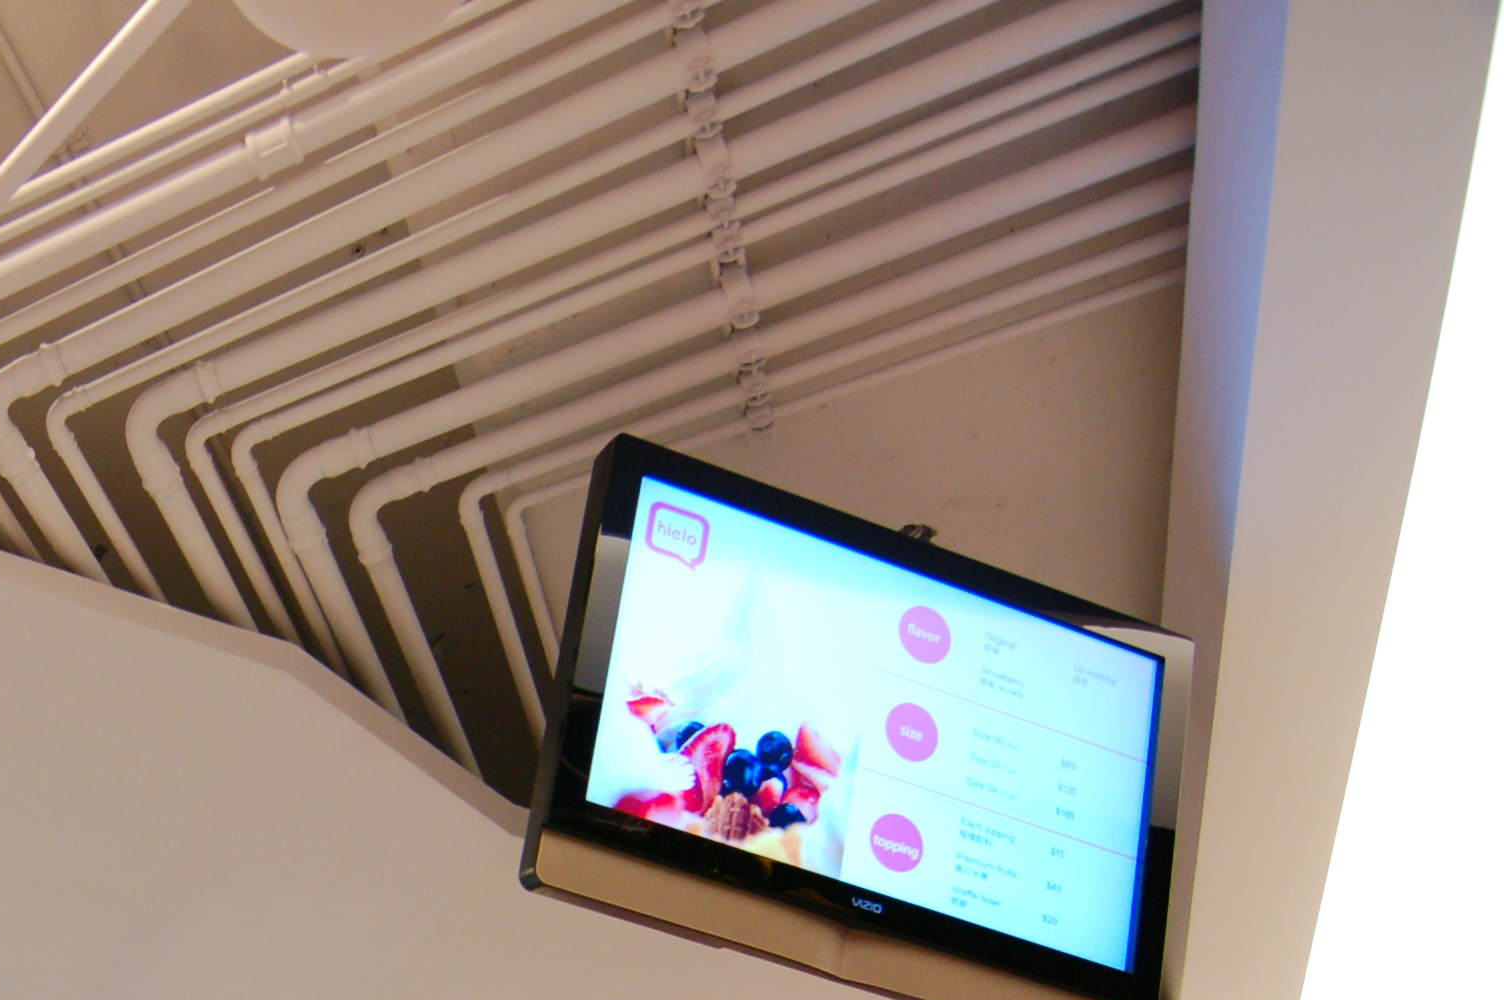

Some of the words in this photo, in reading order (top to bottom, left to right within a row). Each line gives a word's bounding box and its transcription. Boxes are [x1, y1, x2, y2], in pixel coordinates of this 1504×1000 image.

[657, 519, 697, 546] hielo
[908, 623, 940, 643] flavor
[983, 632, 1016, 649] Original
[980, 665, 1024, 689] Strawberry
[900, 725, 923, 742] size
[972, 728, 991, 742] Size
[969, 752, 988, 766] Size
[966, 776, 985, 791] Size
[1057, 782, 1078, 797] $125
[960, 817, 983, 831] Each
[984, 826, 1016, 844] topping
[873, 834, 919, 861] topping
[956, 851, 994, 870] Premium
[951, 884, 979, 900] Waffle
[1046, 880, 1063, 893] $40
